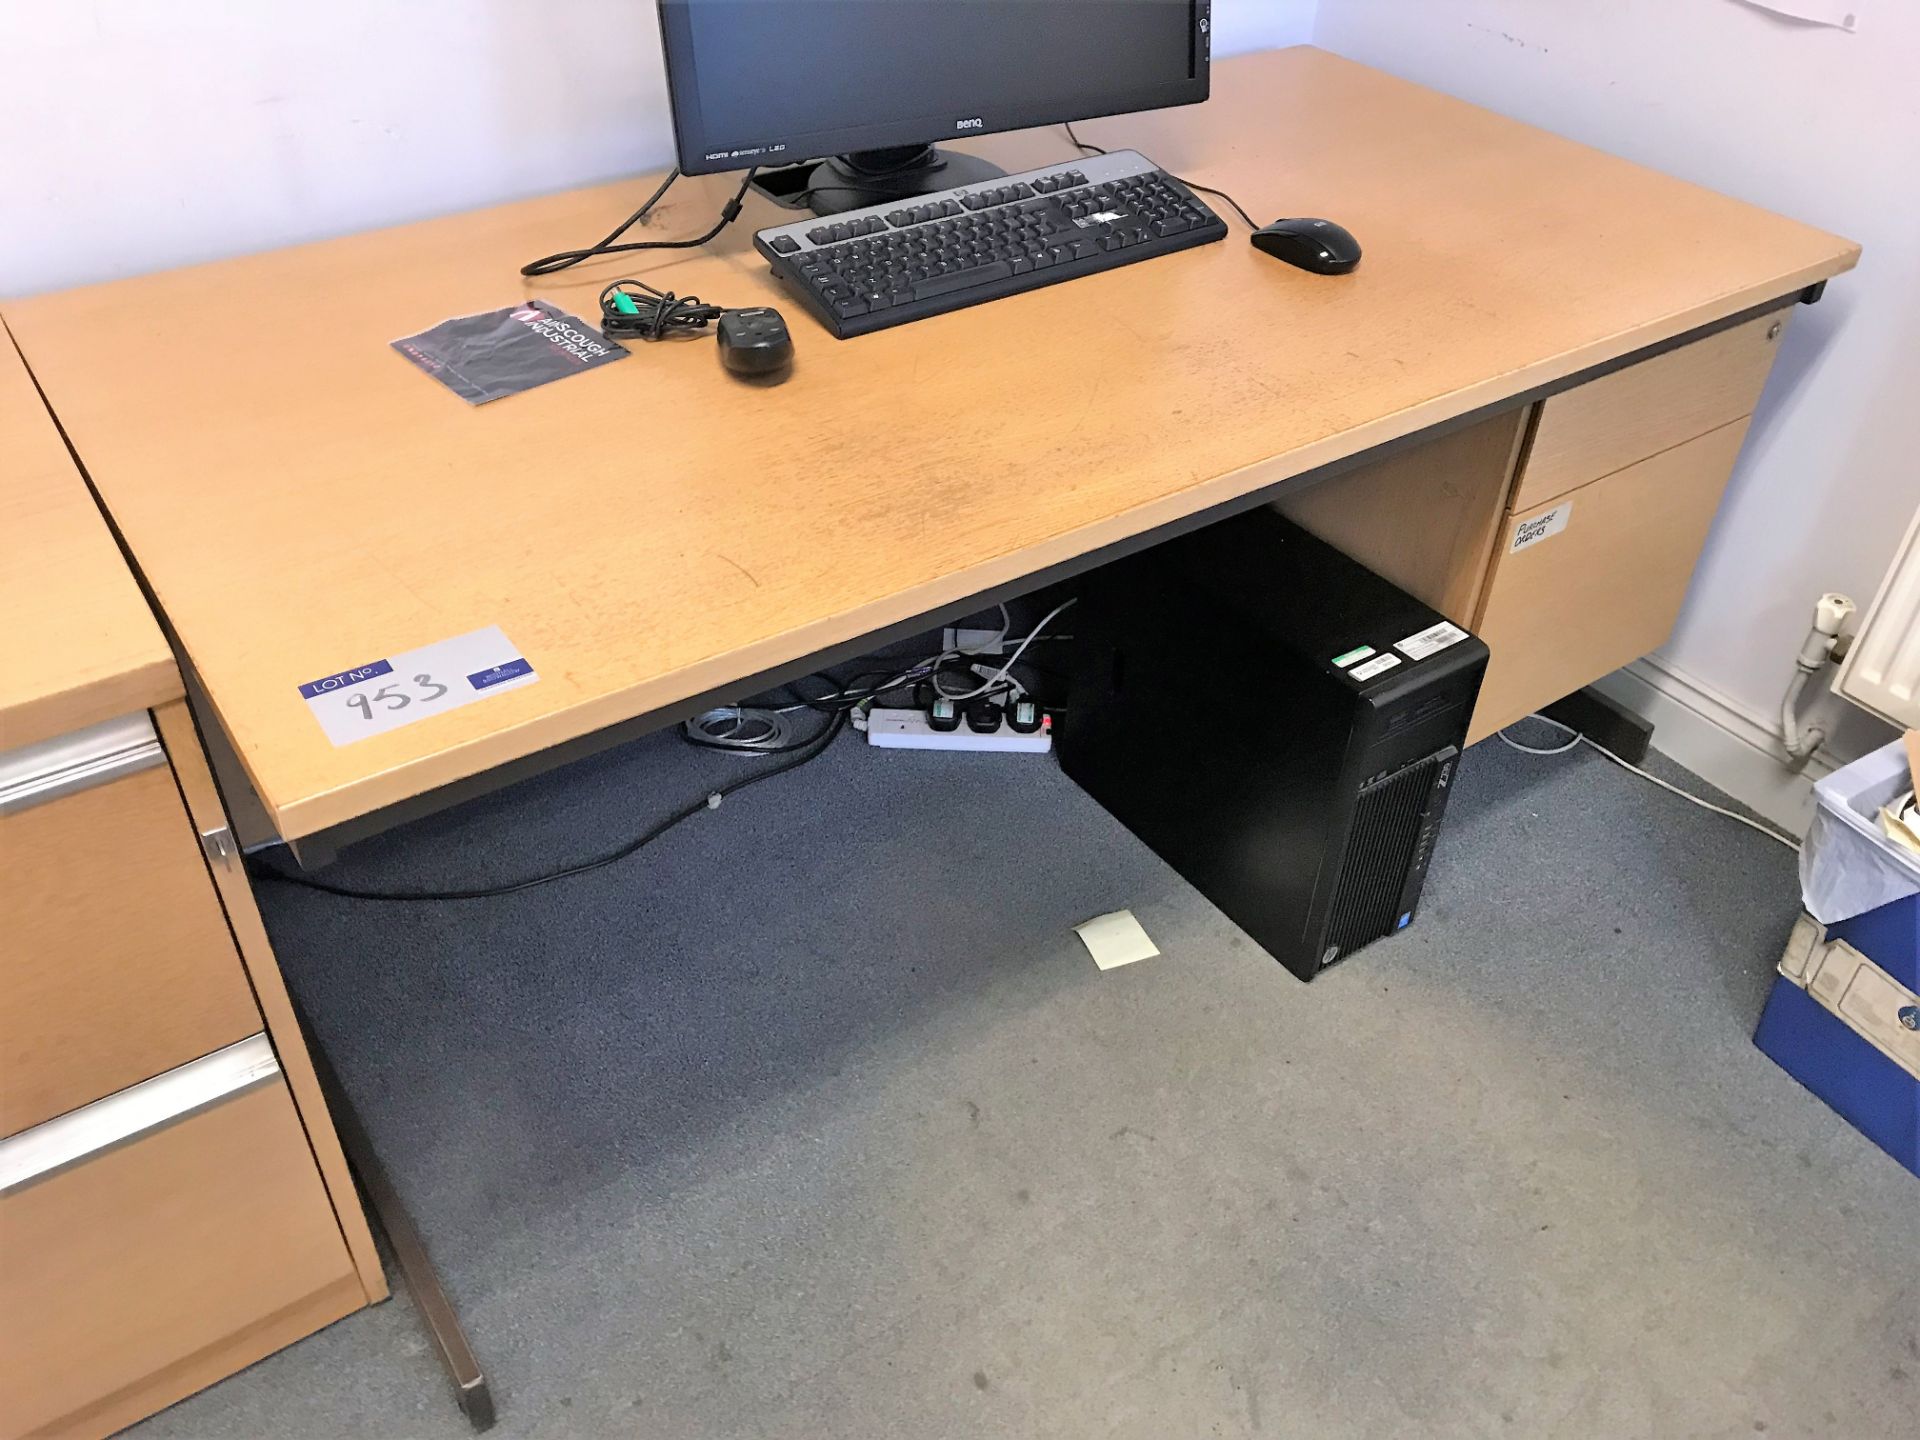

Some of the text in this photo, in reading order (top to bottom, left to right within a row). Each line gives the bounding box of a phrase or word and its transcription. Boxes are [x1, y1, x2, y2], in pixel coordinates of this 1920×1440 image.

[956, 118, 983, 129] BenQ
[769, 144, 786, 152] LED
[705, 151, 729, 161] HDMI
[313, 675, 345, 694] LOT
[346, 674, 448, 720] 953
